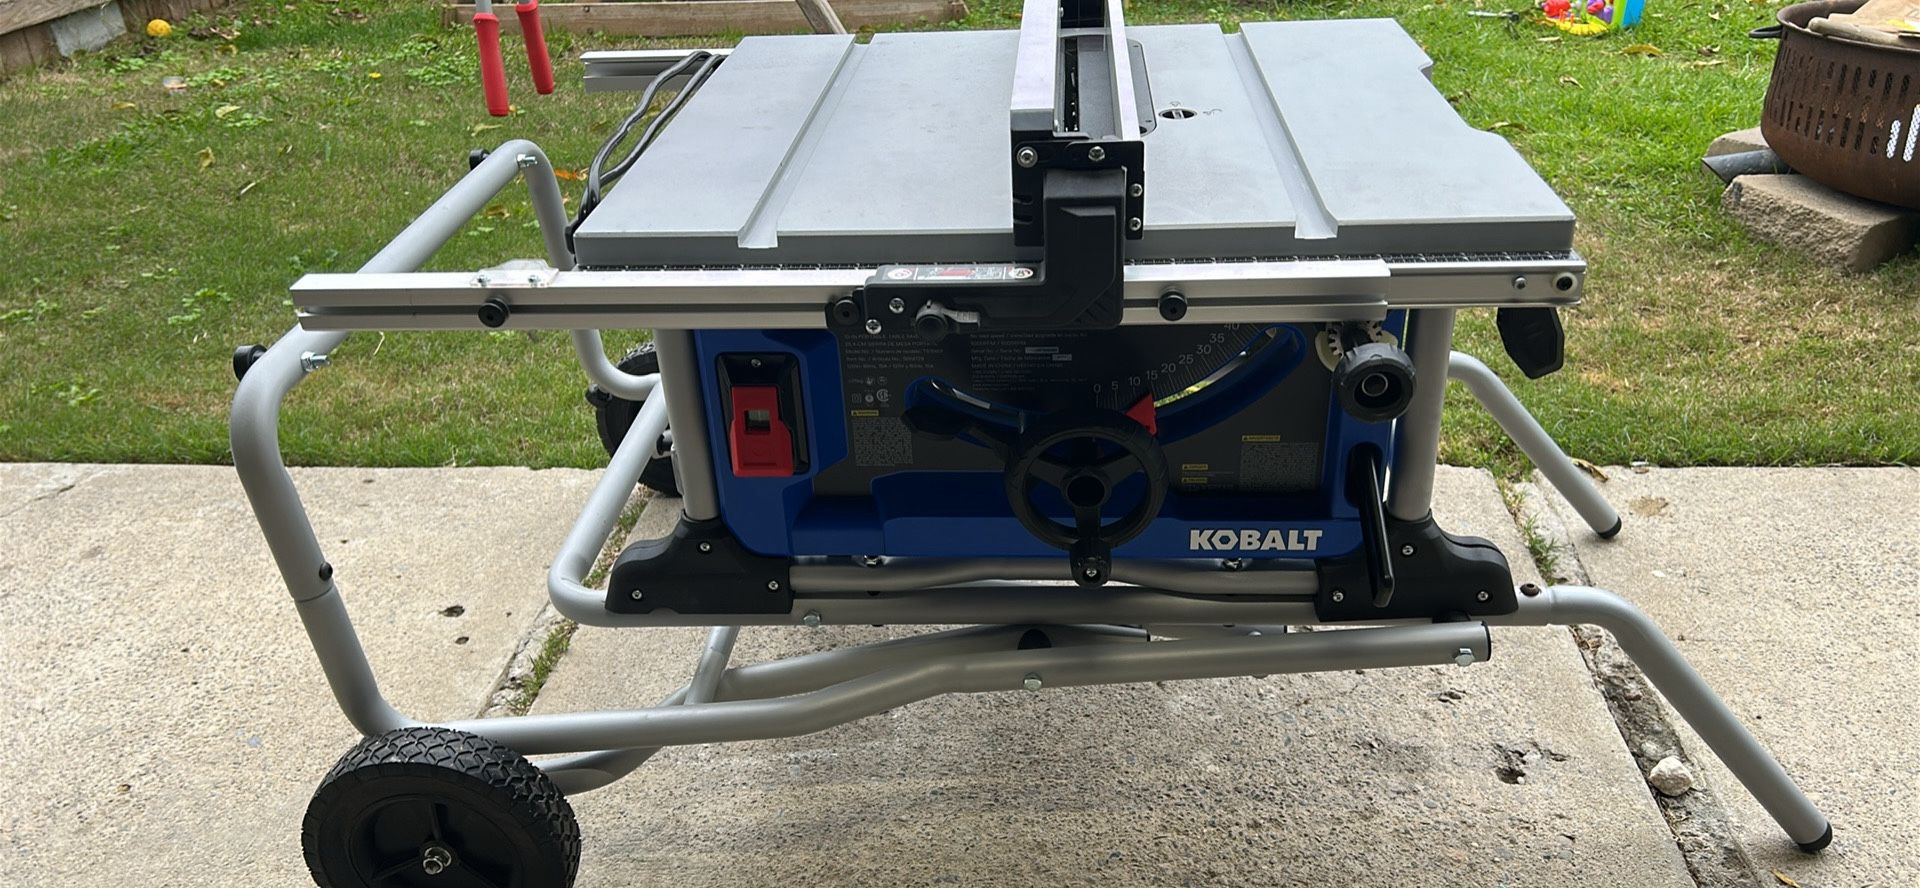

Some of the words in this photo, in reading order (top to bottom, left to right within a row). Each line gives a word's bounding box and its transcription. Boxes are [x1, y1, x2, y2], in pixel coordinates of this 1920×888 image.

[1209, 333, 1225, 343] 35
[1196, 344, 1211, 354] 30
[1178, 354, 1194, 364] 25
[1161, 363, 1176, 373] 20
[1146, 370, 1158, 380] 15
[1111, 381, 1119, 390] 5
[1128, 376, 1141, 386] 10
[1093, 384, 1101, 393] 0
[1189, 529, 1323, 551] KOBALT
